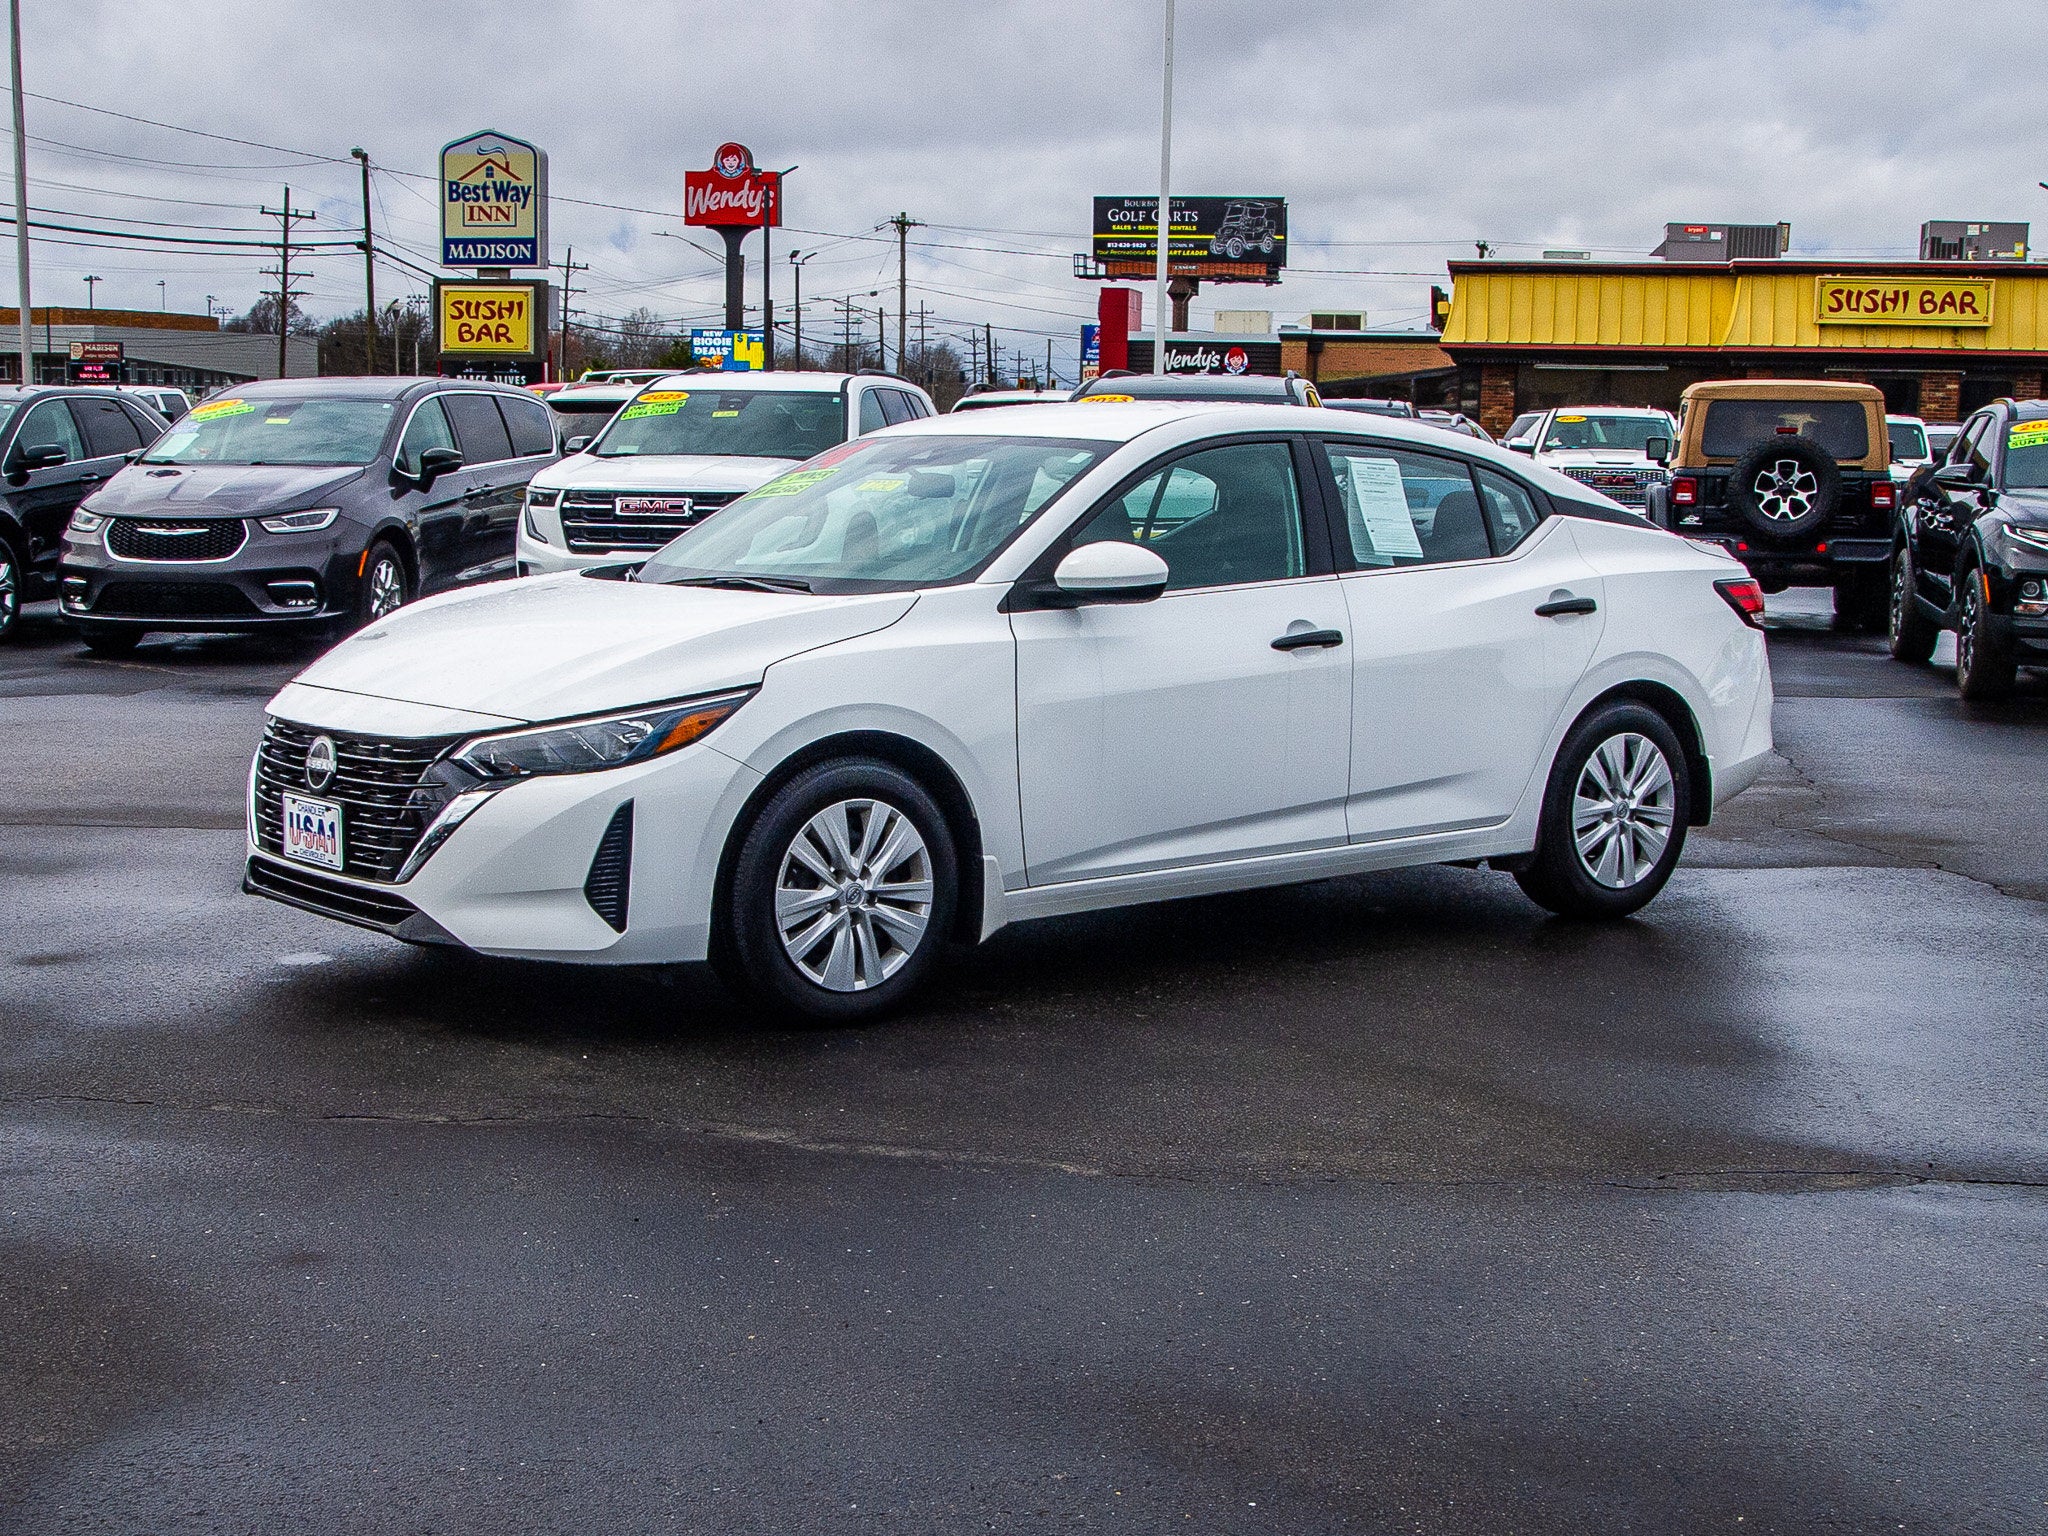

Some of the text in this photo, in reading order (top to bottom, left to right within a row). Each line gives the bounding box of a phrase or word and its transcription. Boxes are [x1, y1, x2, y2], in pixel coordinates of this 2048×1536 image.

[1124, 199, 1158, 207] BOURBO
[467, 205, 511, 221] INN
[1107, 208, 1146, 222] GOLF
[448, 243, 531, 259] MADISON
[1827, 288, 1980, 315] SUSHI BAR
[449, 299, 524, 320] SUSHI
[457, 322, 514, 344] BAR
[692, 337, 732, 346] BIGGIE
[1593, 475, 1636, 487] GMC
[620, 499, 685, 514] GMC
[297, 802, 326, 818] CHANDLER
[299, 848, 326, 861] CHEVROLET
